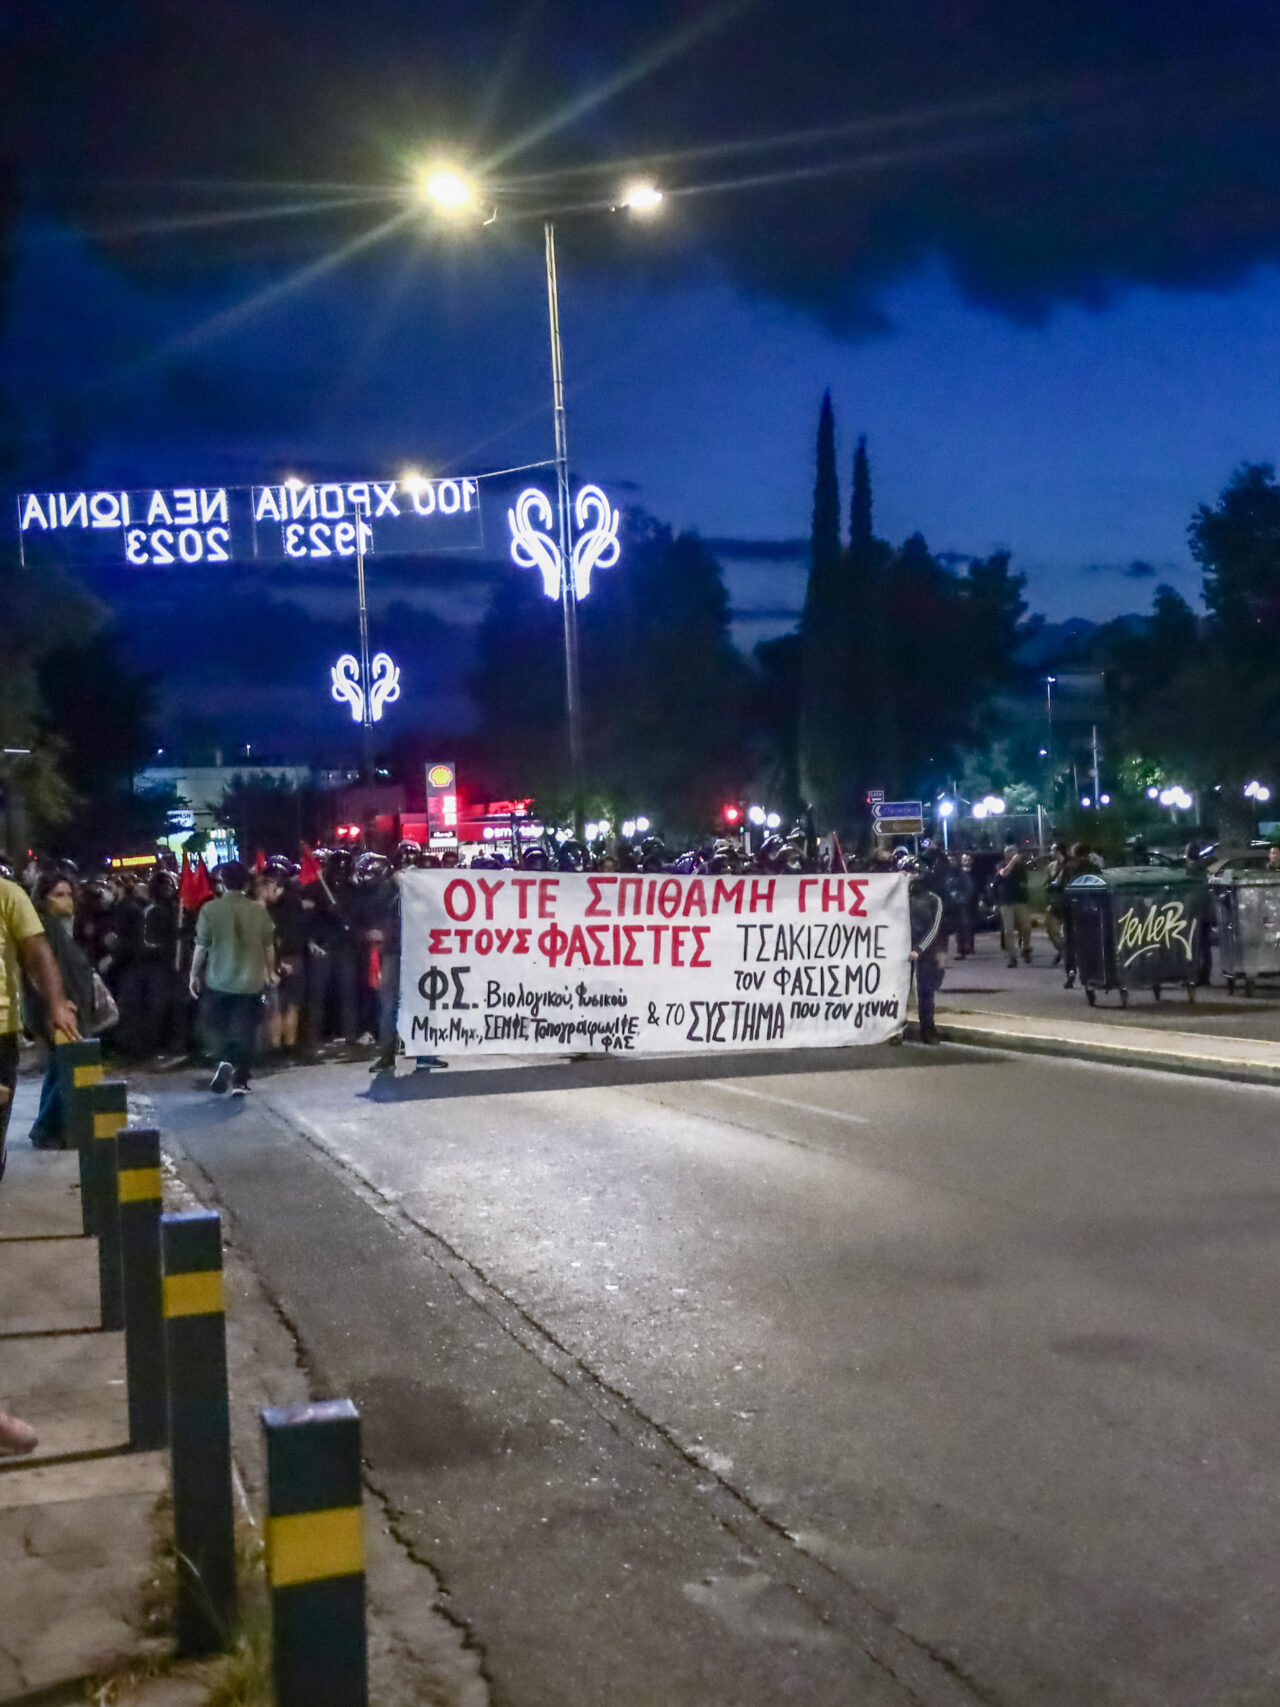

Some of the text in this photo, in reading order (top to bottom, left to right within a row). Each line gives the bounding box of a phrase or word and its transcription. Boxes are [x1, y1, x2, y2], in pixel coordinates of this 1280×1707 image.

[443, 876, 869, 922] ΟΥΤΕ ΣΠΙΘΑΜΗ ΓΗΣ
[428, 922, 712, 968] ΣΤΟΥΣ ΦΑΣΙΣΤΕΣ
[736, 923, 890, 962] ΤΣΑΚΙΖΟΥΜΕ
[418, 966, 479, 1011] Φ.Σ.
[734, 962, 881, 997] τον ΦΑΣΙΣΜΟ
[647, 1001, 660, 1026] &
[686, 1001, 785, 1043] ΣΥΣΤΗΜΑ
[790, 1001, 820, 1019] που
[825, 1002, 854, 1021] τον
